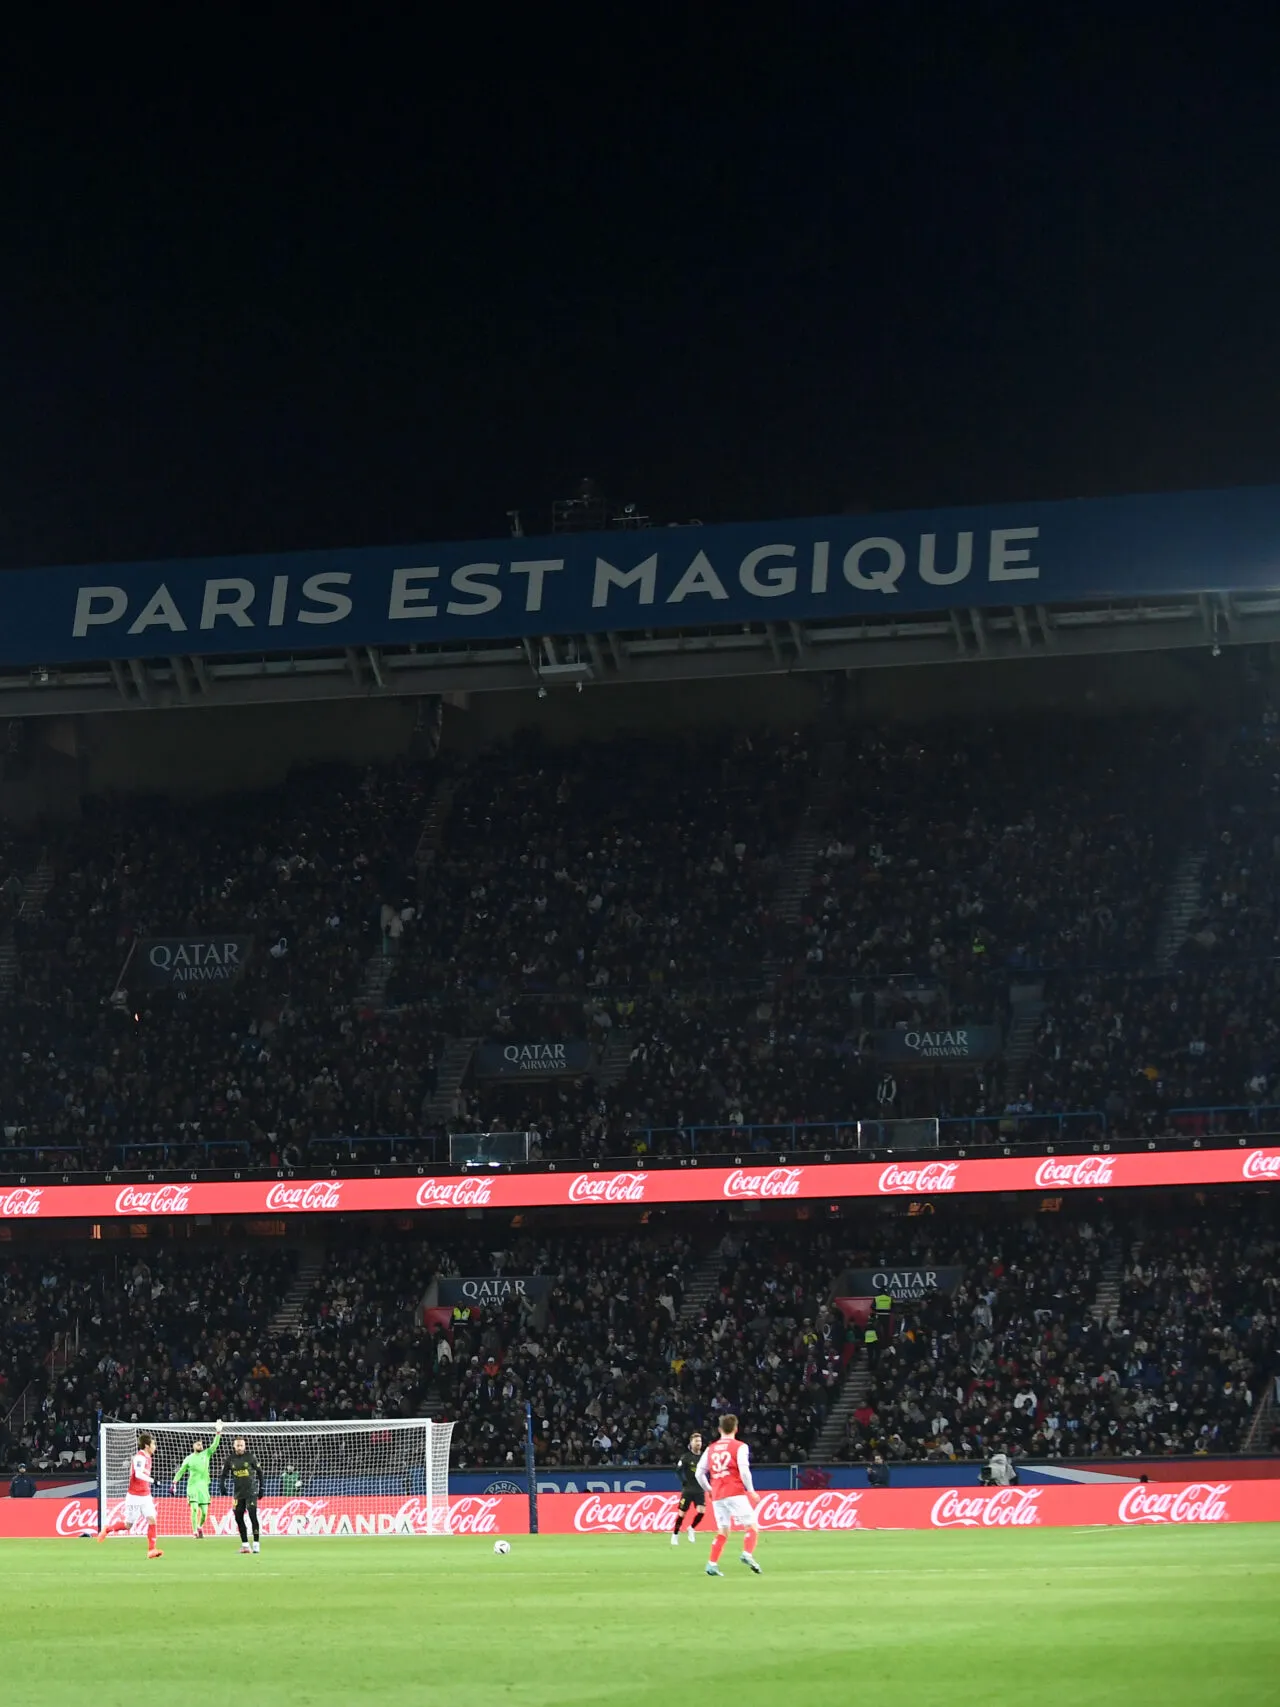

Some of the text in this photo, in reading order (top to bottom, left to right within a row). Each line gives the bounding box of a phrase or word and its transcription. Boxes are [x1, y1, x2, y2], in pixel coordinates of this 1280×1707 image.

[72, 526, 1041, 638] PARIS EST MAGIQUE
[149, 943, 240, 972] QATAR
[504, 1043, 566, 1062] QATAR
[904, 1030, 968, 1050] QATAR
[921, 1046, 969, 1057] AIRWAYS
[519, 1058, 567, 1070] AIRWAYS
[724, 1168, 803, 1197] Coca-Cola
[879, 1163, 959, 1193] Coca-Cola
[1035, 1157, 1115, 1187] Coca-Cola
[116, 1186, 193, 1213] Coca-Cola
[266, 1182, 343, 1210] Coca-Cola
[416, 1178, 492, 1206] Coca-Cola
[569, 1173, 648, 1202] Coca-Cola
[872, 1271, 938, 1290] QATAR
[711, 1451, 732, 1473] 32
[755, 1492, 864, 1530] Coca-Cola
[931, 1488, 1044, 1527] Coca-Cola
[1119, 1484, 1232, 1525] Coca-Cola
